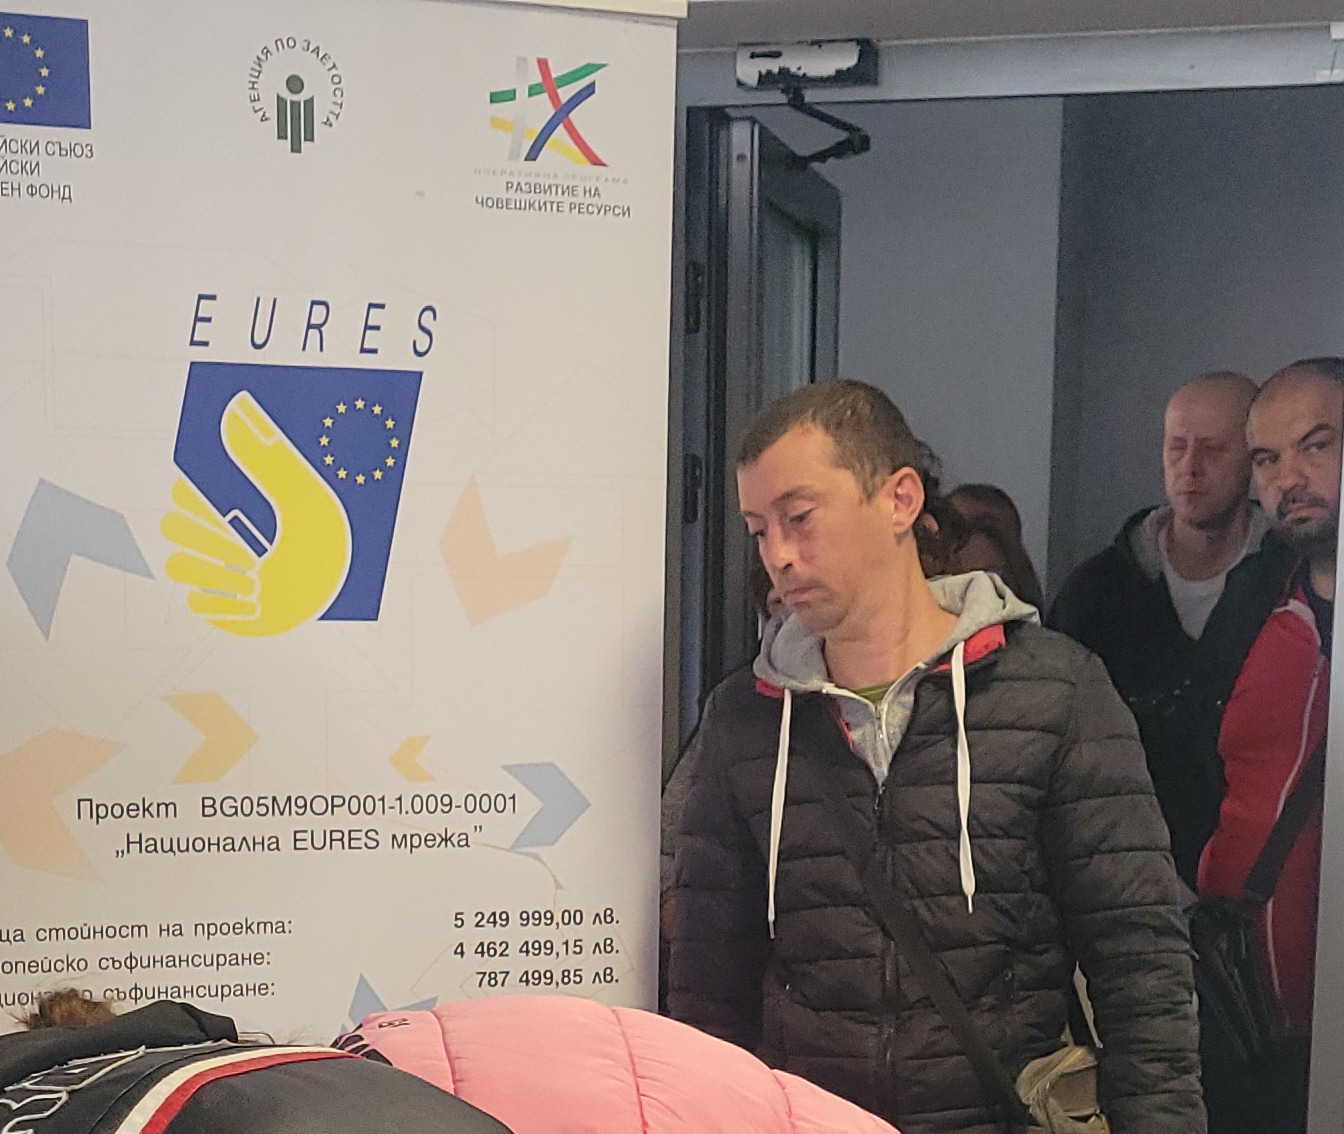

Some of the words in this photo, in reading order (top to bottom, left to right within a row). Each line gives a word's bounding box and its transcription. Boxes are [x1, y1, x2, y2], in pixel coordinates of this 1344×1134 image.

[248, 46, 273, 123] АГЕНЦИЯ
[274, 36, 297, 53] ПО
[302, 39, 344, 128] ЗАЕТОСТТА
[45, 140, 94, 159] СЪЮЗ
[26, 182, 73, 203] ФОНД
[506, 181, 579, 199] РАЗВИТИЕ
[583, 185, 602, 199] НА
[475, 195, 565, 214] ЧОВЕШКИТЕ
[569, 201, 631, 218] РЕСУРСИ
[189, 293, 437, 358] EURES
[76, 797, 178, 824] Проект
[293, 828, 380, 852] EURES
[35, 922, 148, 942] стойност
[158, 921, 184, 938] на
[193, 917, 293, 940] проекта:
[454, 912, 465, 928] 5
[474, 910, 510, 928] 249
[519, 908, 583, 930] 999,00
[592, 907, 620, 926] лв.
[453, 942, 465, 958] 4
[474, 940, 510, 958] 462
[519, 938, 583, 960] 499,15
[592, 937, 620, 955] лв.
[98, 949, 272, 974] съфинансиране:
[476, 970, 510, 988] 787
[519, 968, 583, 990] 499,85
[592, 966, 620, 985] лв.
[103, 979, 276, 1003] съфинансиране:
